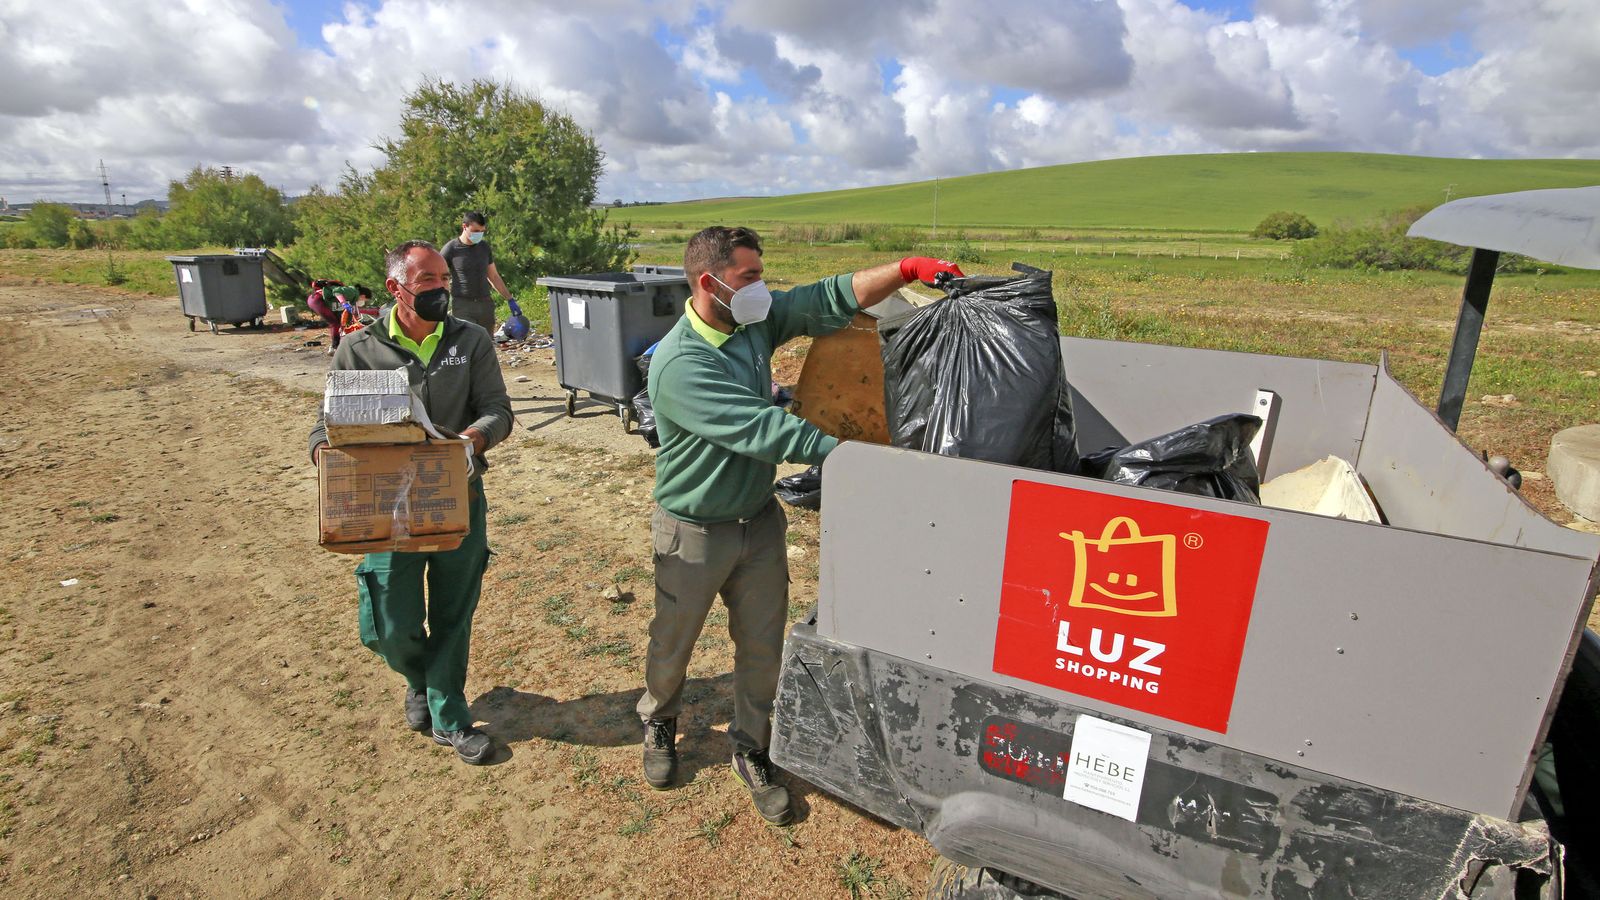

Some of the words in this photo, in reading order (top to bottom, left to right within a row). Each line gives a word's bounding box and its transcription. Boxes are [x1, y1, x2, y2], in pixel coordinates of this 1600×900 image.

[441, 356, 467, 366] HEBE
[1056, 620, 1166, 676] LUZ
[1055, 658, 1159, 694] SHOPPING
[1076, 752, 1136, 782] HEBE
